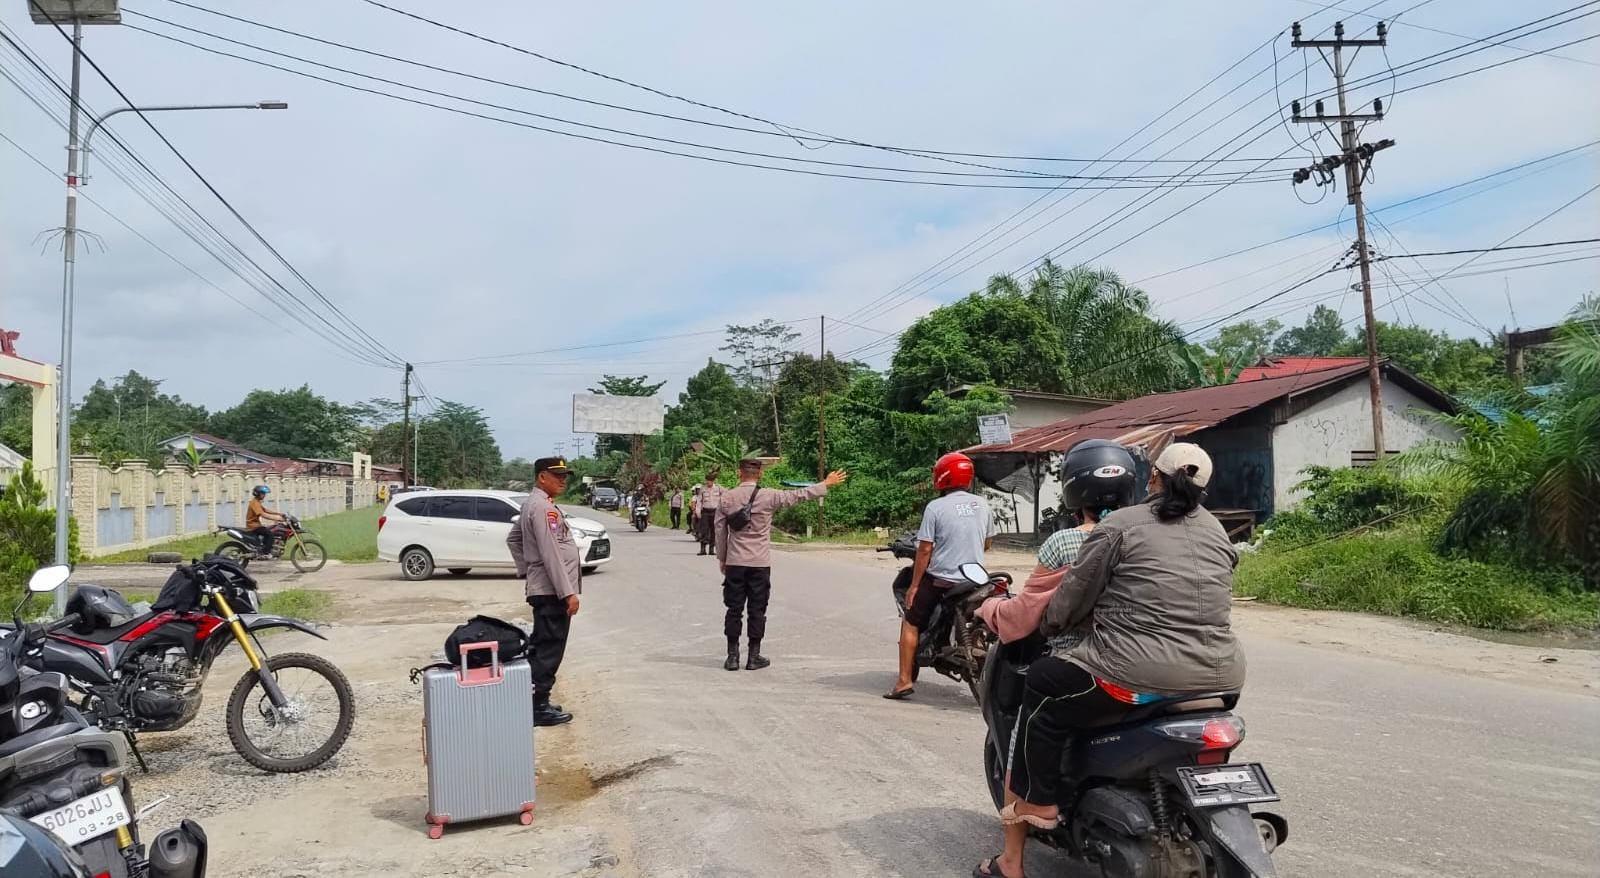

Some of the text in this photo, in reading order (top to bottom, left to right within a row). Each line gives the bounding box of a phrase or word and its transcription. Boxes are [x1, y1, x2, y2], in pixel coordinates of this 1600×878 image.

[1102, 467, 1121, 475] GM
[43, 793, 113, 832] 6026 UJ
